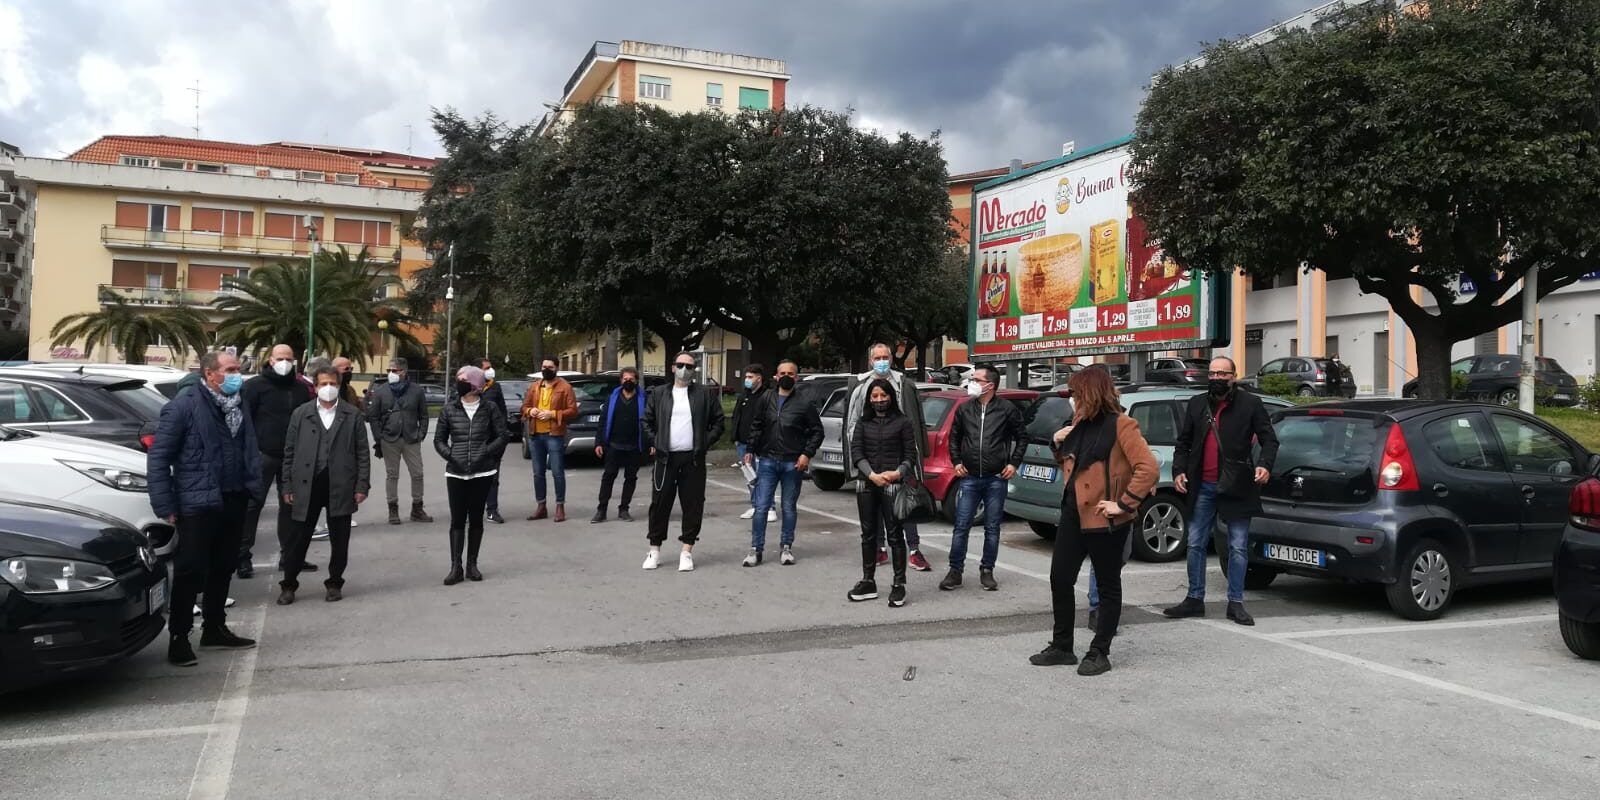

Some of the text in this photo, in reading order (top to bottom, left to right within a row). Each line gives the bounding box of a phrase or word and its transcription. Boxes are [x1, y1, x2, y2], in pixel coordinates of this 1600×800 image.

[980, 197, 1046, 234] Mercadò
[1102, 310, 1125, 329] 1,29
[1164, 302, 1190, 321] 1,89
[1000, 322, 1018, 338] 1,39
[1047, 316, 1068, 333] 7,99
[1012, 343, 1035, 351] OFFERTE
[1035, 342, 1055, 350] VALIDE
